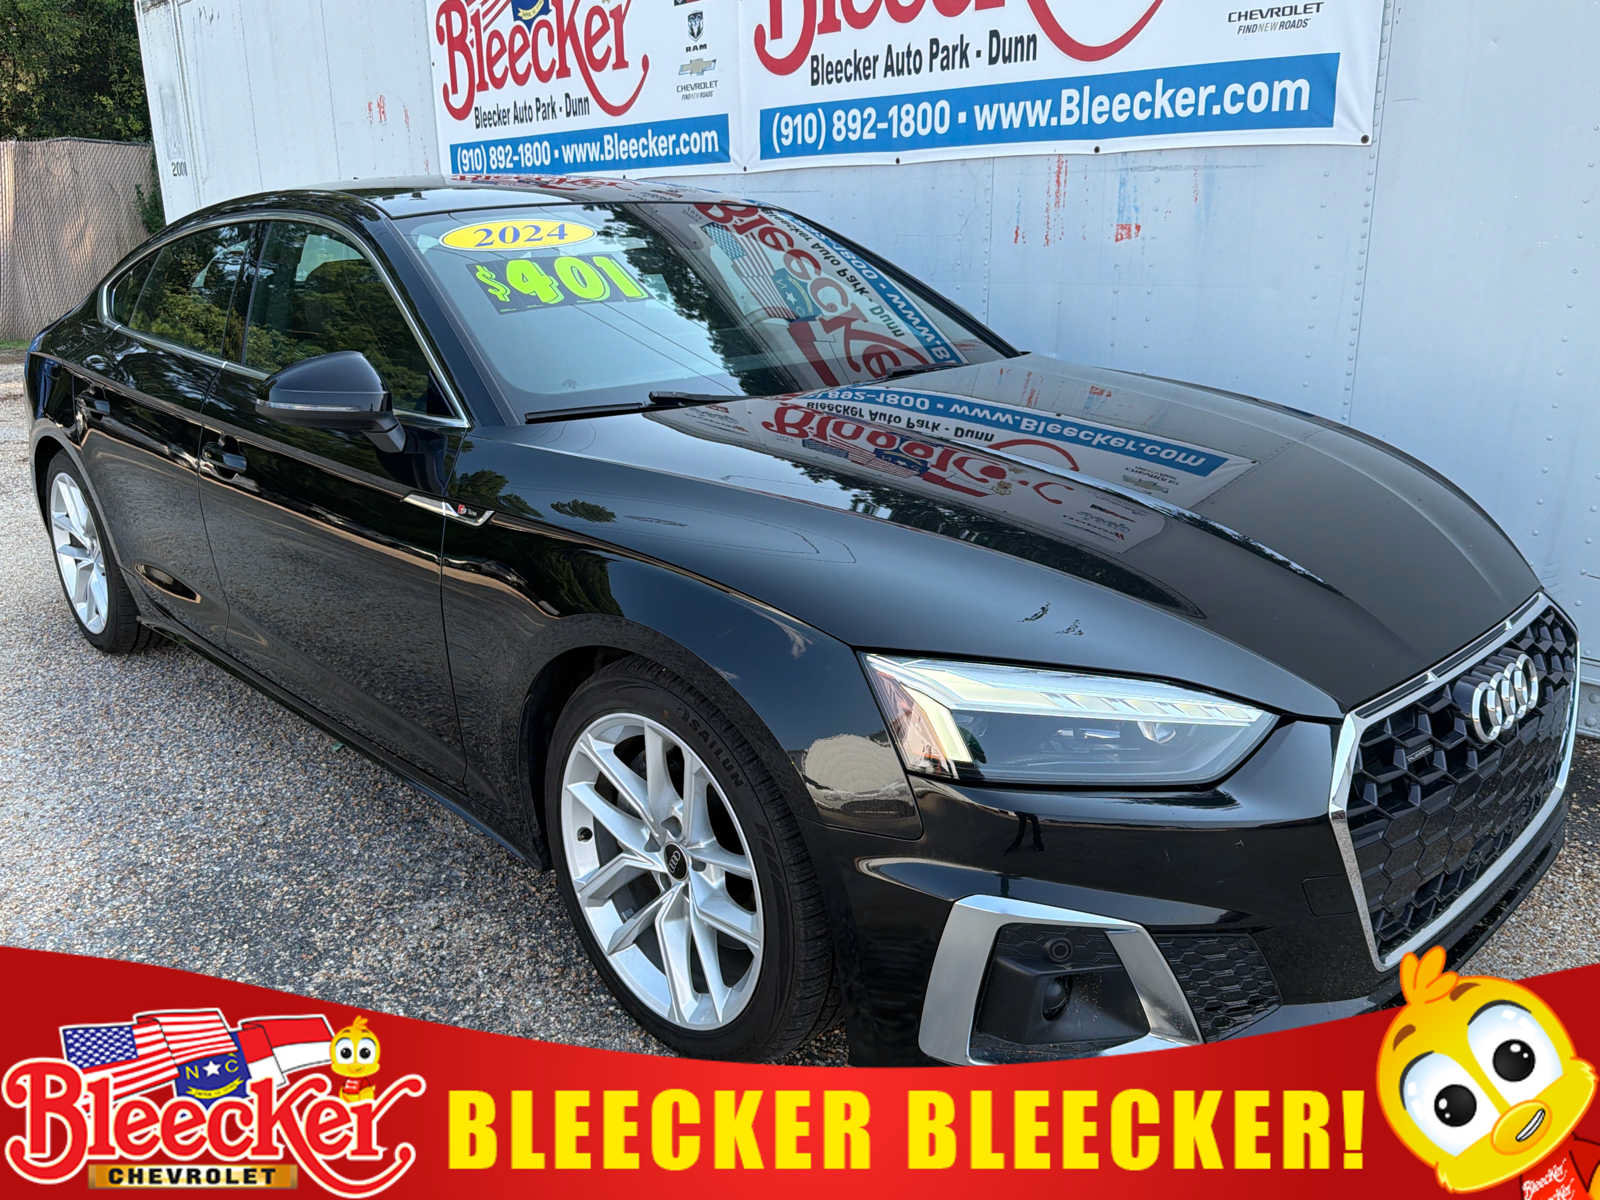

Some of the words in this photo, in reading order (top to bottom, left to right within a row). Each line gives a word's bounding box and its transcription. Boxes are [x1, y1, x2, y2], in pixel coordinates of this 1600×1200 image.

[1228, 2, 1324, 23] CHEVROLET
[685, 44, 707, 53] RAM
[810, 48, 879, 86] Bleecker
[883, 42, 922, 77] Auto
[929, 33, 970, 72] Park
[988, 30, 1037, 65] Dunn
[474, 105, 511, 129] Bleecker
[513, 101, 533, 125] Auto
[536, 95, 557, 121] Park
[565, 93, 590, 117] Dunn
[772, 112, 826, 154] (910)
[833, 100, 950, 142] 892-1800
[974, 77, 1310, 131] www.Bleecker.com
[457, 146, 487, 174] (910)
[490, 141, 550, 167] 892-1800
[562, 128, 719, 164] www.Bleecker.com
[473, 223, 568, 248] 2024
[475, 255, 649, 304] $401
[689, 719, 745, 788] SAILUN
